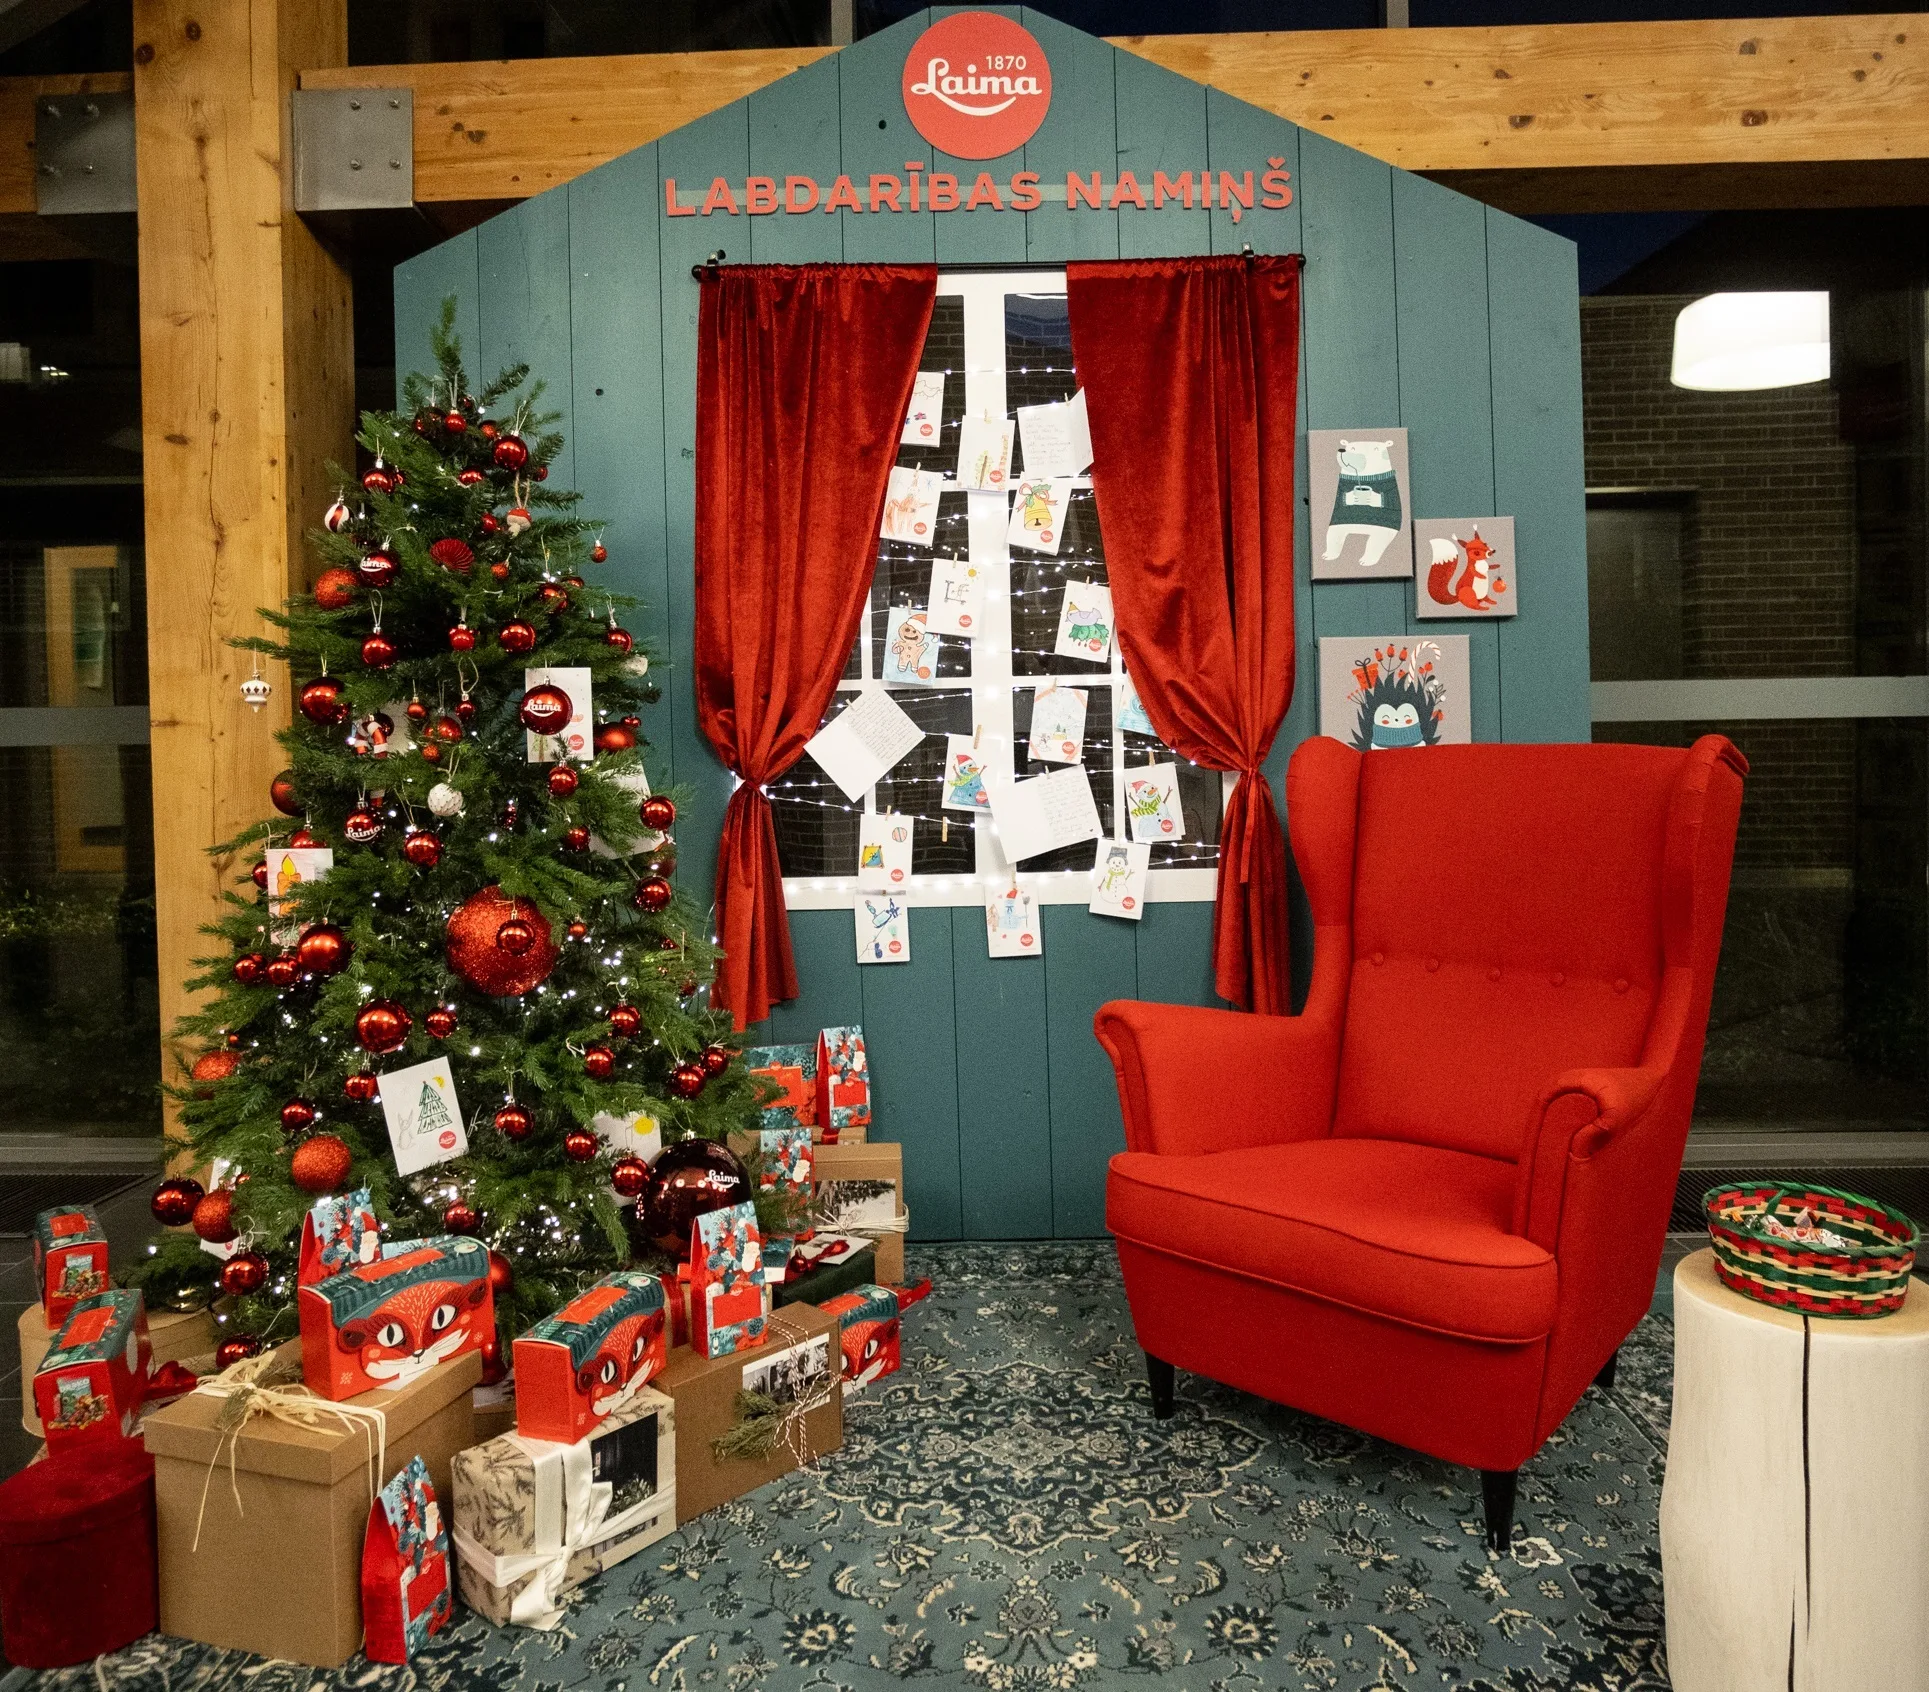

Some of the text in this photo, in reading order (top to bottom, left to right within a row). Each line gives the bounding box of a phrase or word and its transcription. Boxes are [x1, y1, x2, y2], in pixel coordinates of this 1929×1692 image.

[986, 55, 1027, 70] 1870
[911, 58, 1042, 116] Laima
[665, 156, 1294, 225] LABDARĪBAS NAMIŅŠ
[524, 699, 562, 717] Laima
[345, 825, 382, 842] Laima
[704, 1169, 740, 1189] Laima
